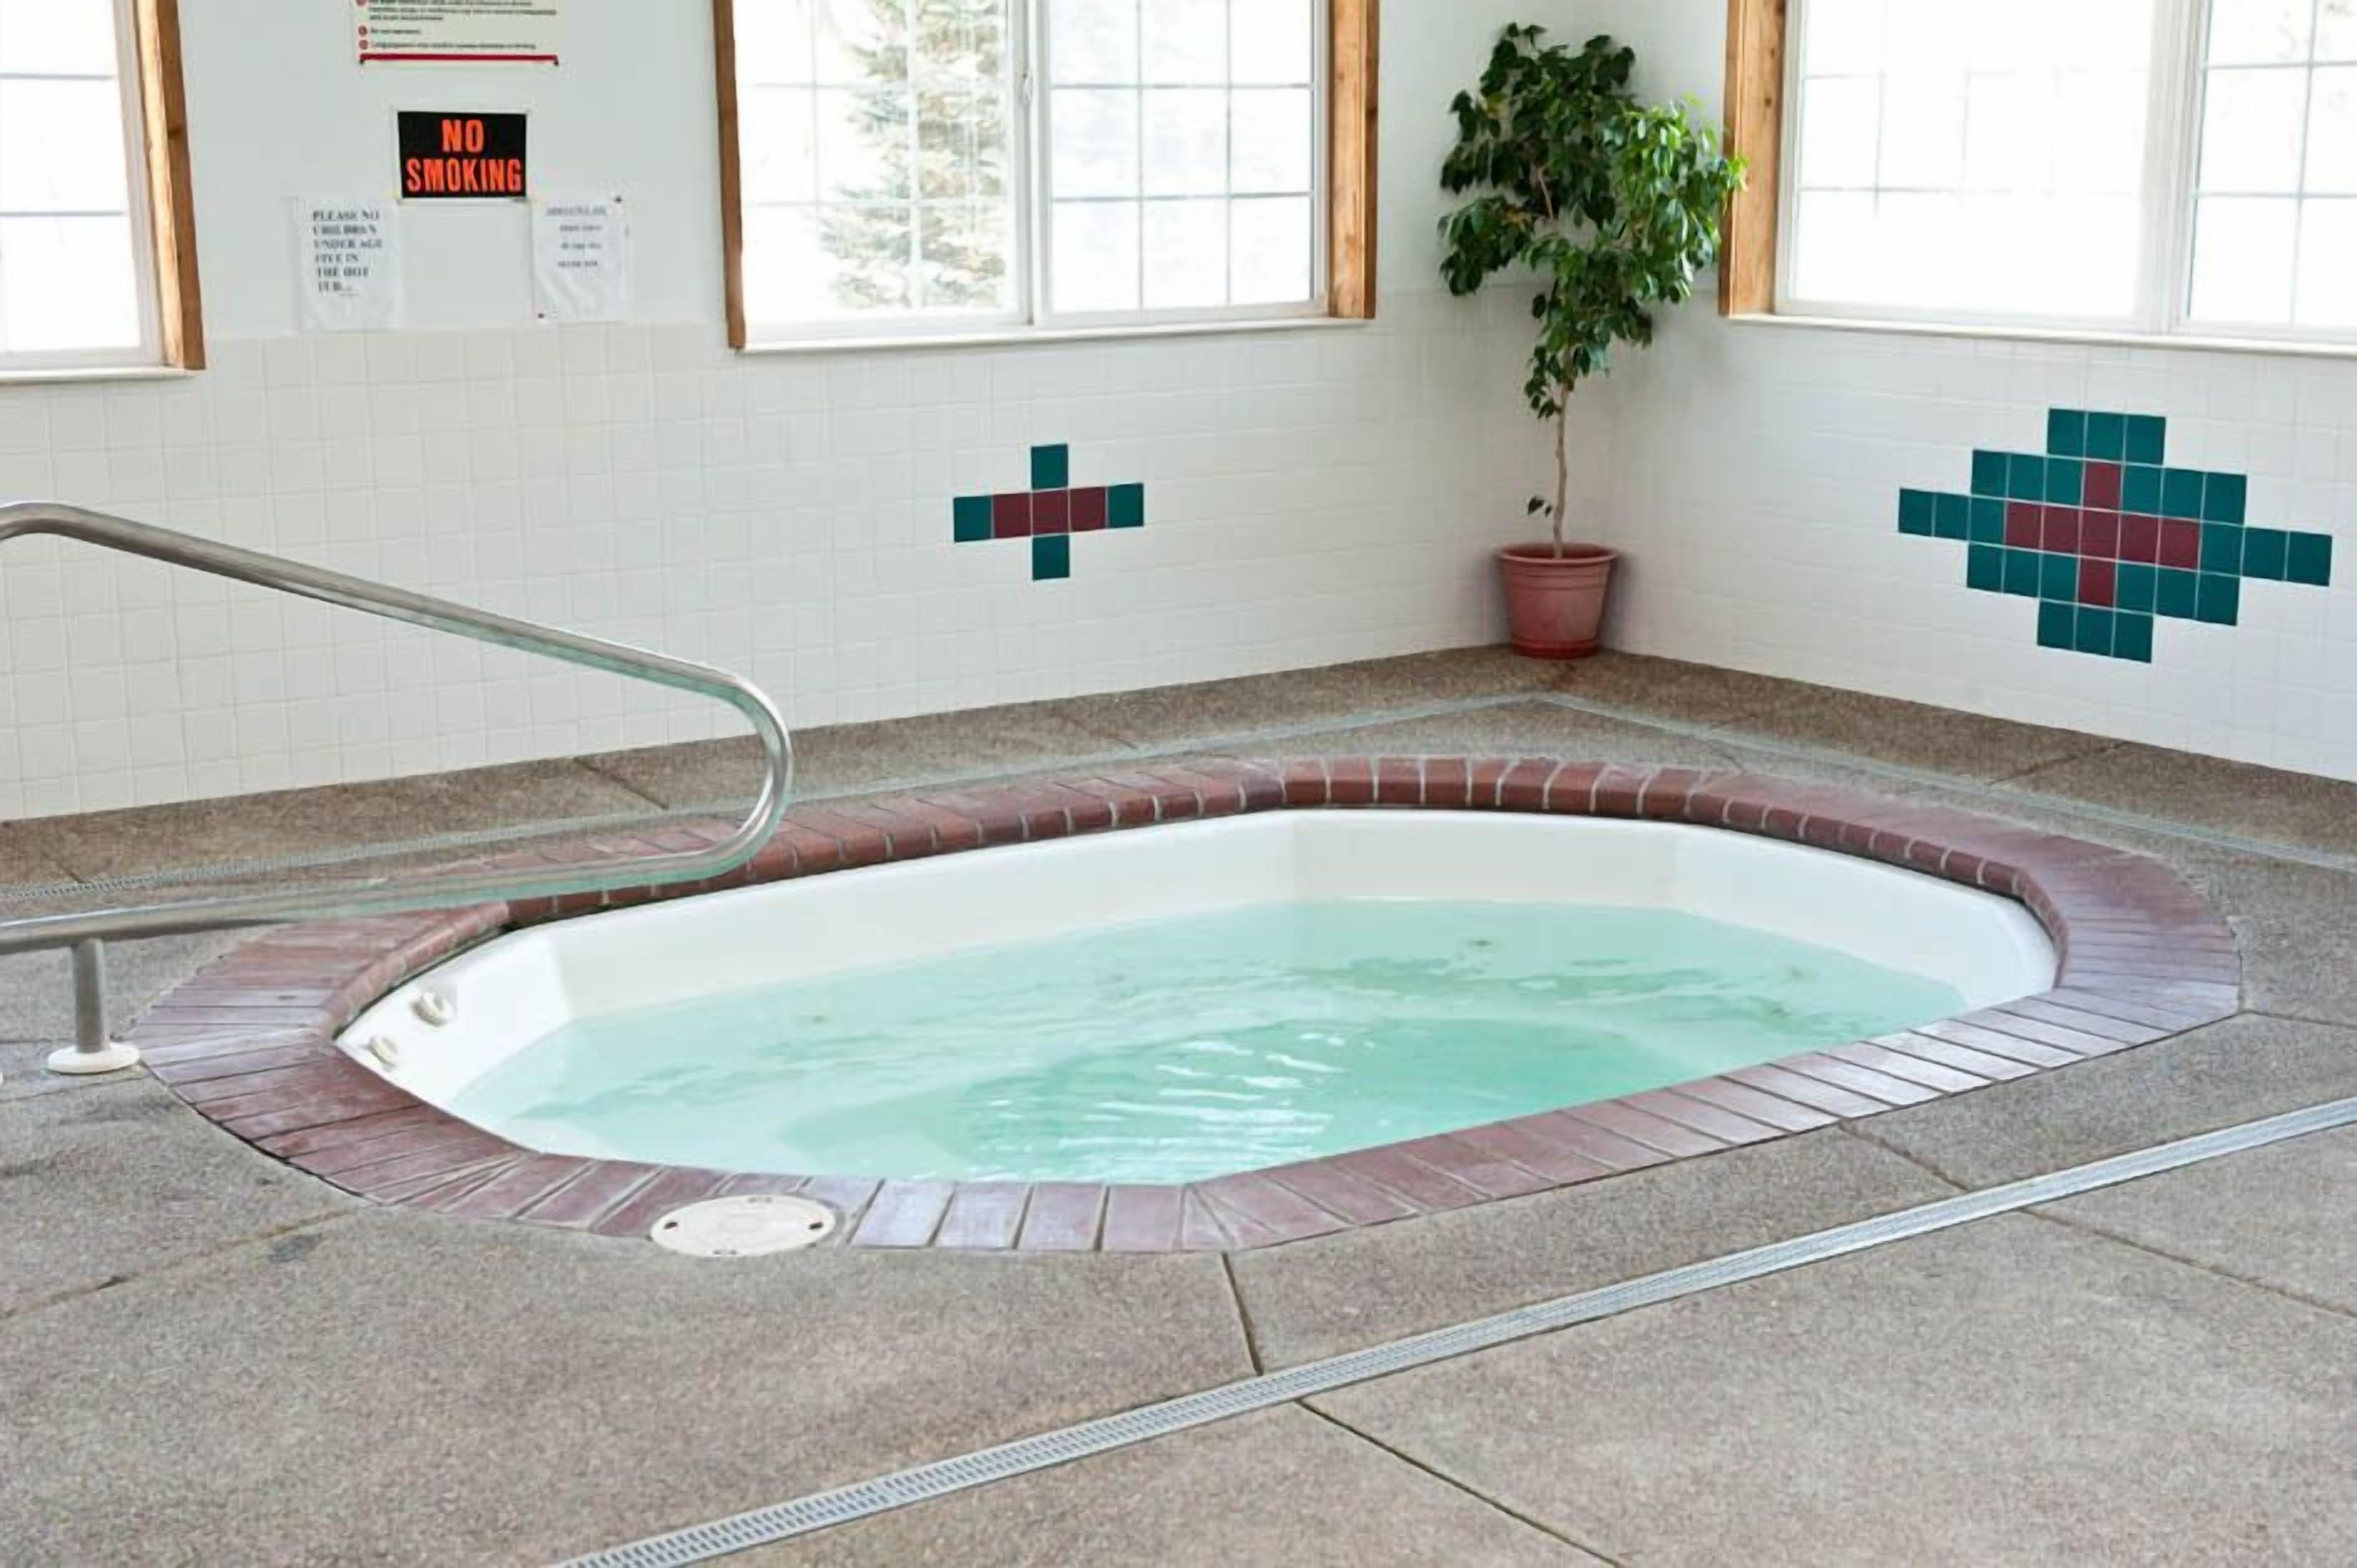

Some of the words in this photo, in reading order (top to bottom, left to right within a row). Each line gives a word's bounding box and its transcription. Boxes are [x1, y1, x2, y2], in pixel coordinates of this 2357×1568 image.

[442, 119, 484, 152] NO
[406, 158, 521, 192] SMOKING
[313, 210, 357, 221] PLEASE
[314, 239, 356, 249] UNDER
